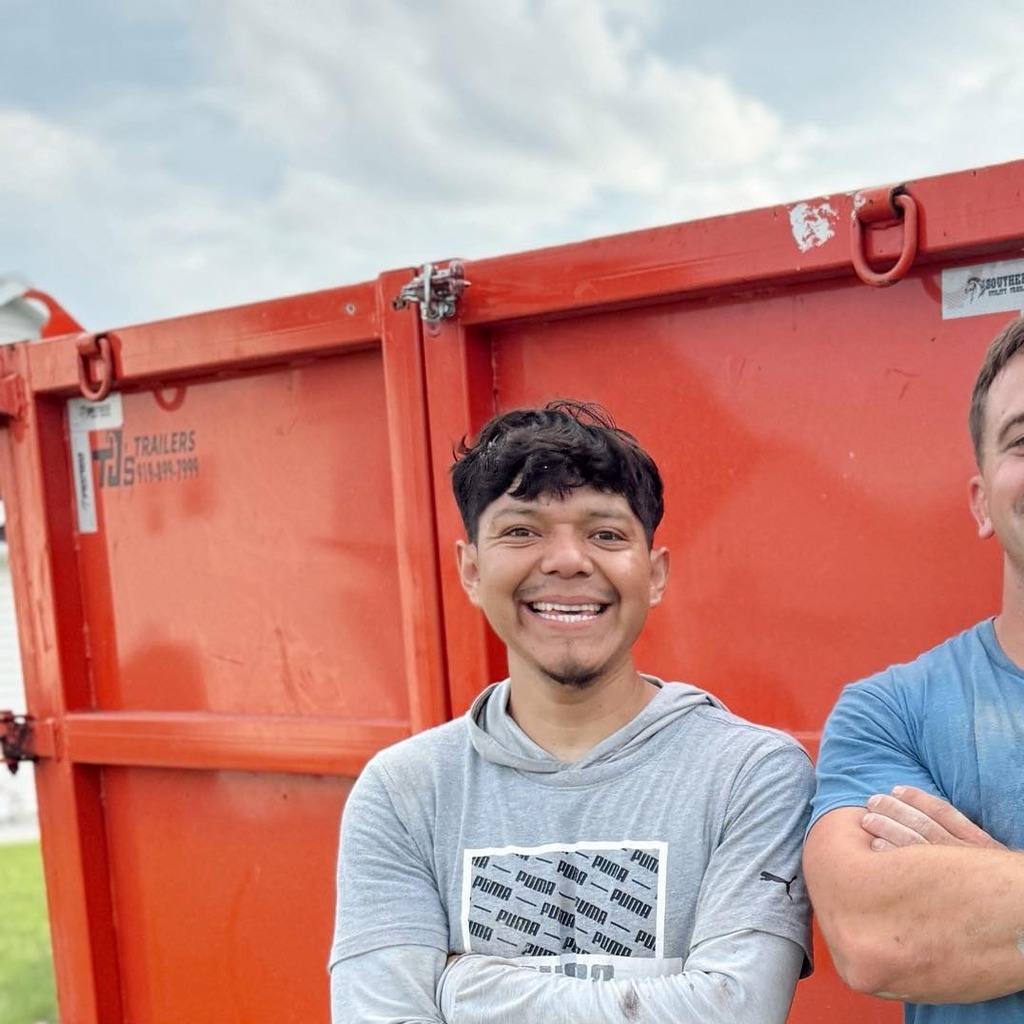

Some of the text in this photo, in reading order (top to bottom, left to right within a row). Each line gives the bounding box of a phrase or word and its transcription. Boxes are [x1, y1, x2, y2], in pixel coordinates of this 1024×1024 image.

[134, 430, 196, 456] TRAILERS
[515, 869, 557, 896] PUMA
[591, 854, 630, 883] PUMA
[472, 875, 513, 901] PUMA
[540, 902, 576, 928] PUMA
[556, 859, 653, 919] PUMA PUMA
[495, 908, 541, 937] PUMA
